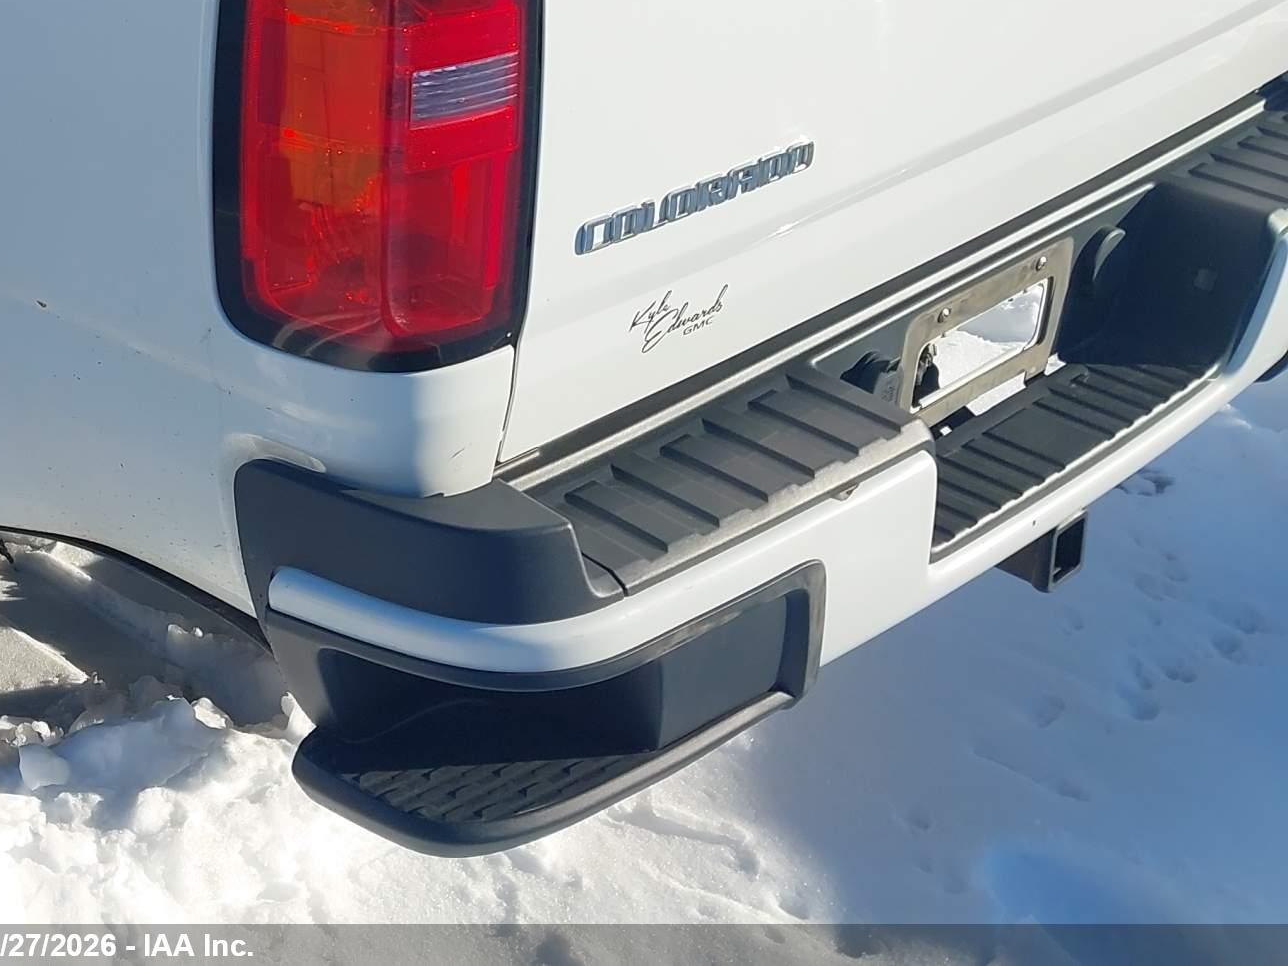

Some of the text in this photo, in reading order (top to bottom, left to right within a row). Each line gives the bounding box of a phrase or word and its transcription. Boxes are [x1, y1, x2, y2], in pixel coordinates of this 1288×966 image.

[574, 141, 815, 256] COLORADO
[629, 289, 673, 333] Kyle
[642, 284, 729, 354] Edwards
[682, 316, 714, 336] GMC
